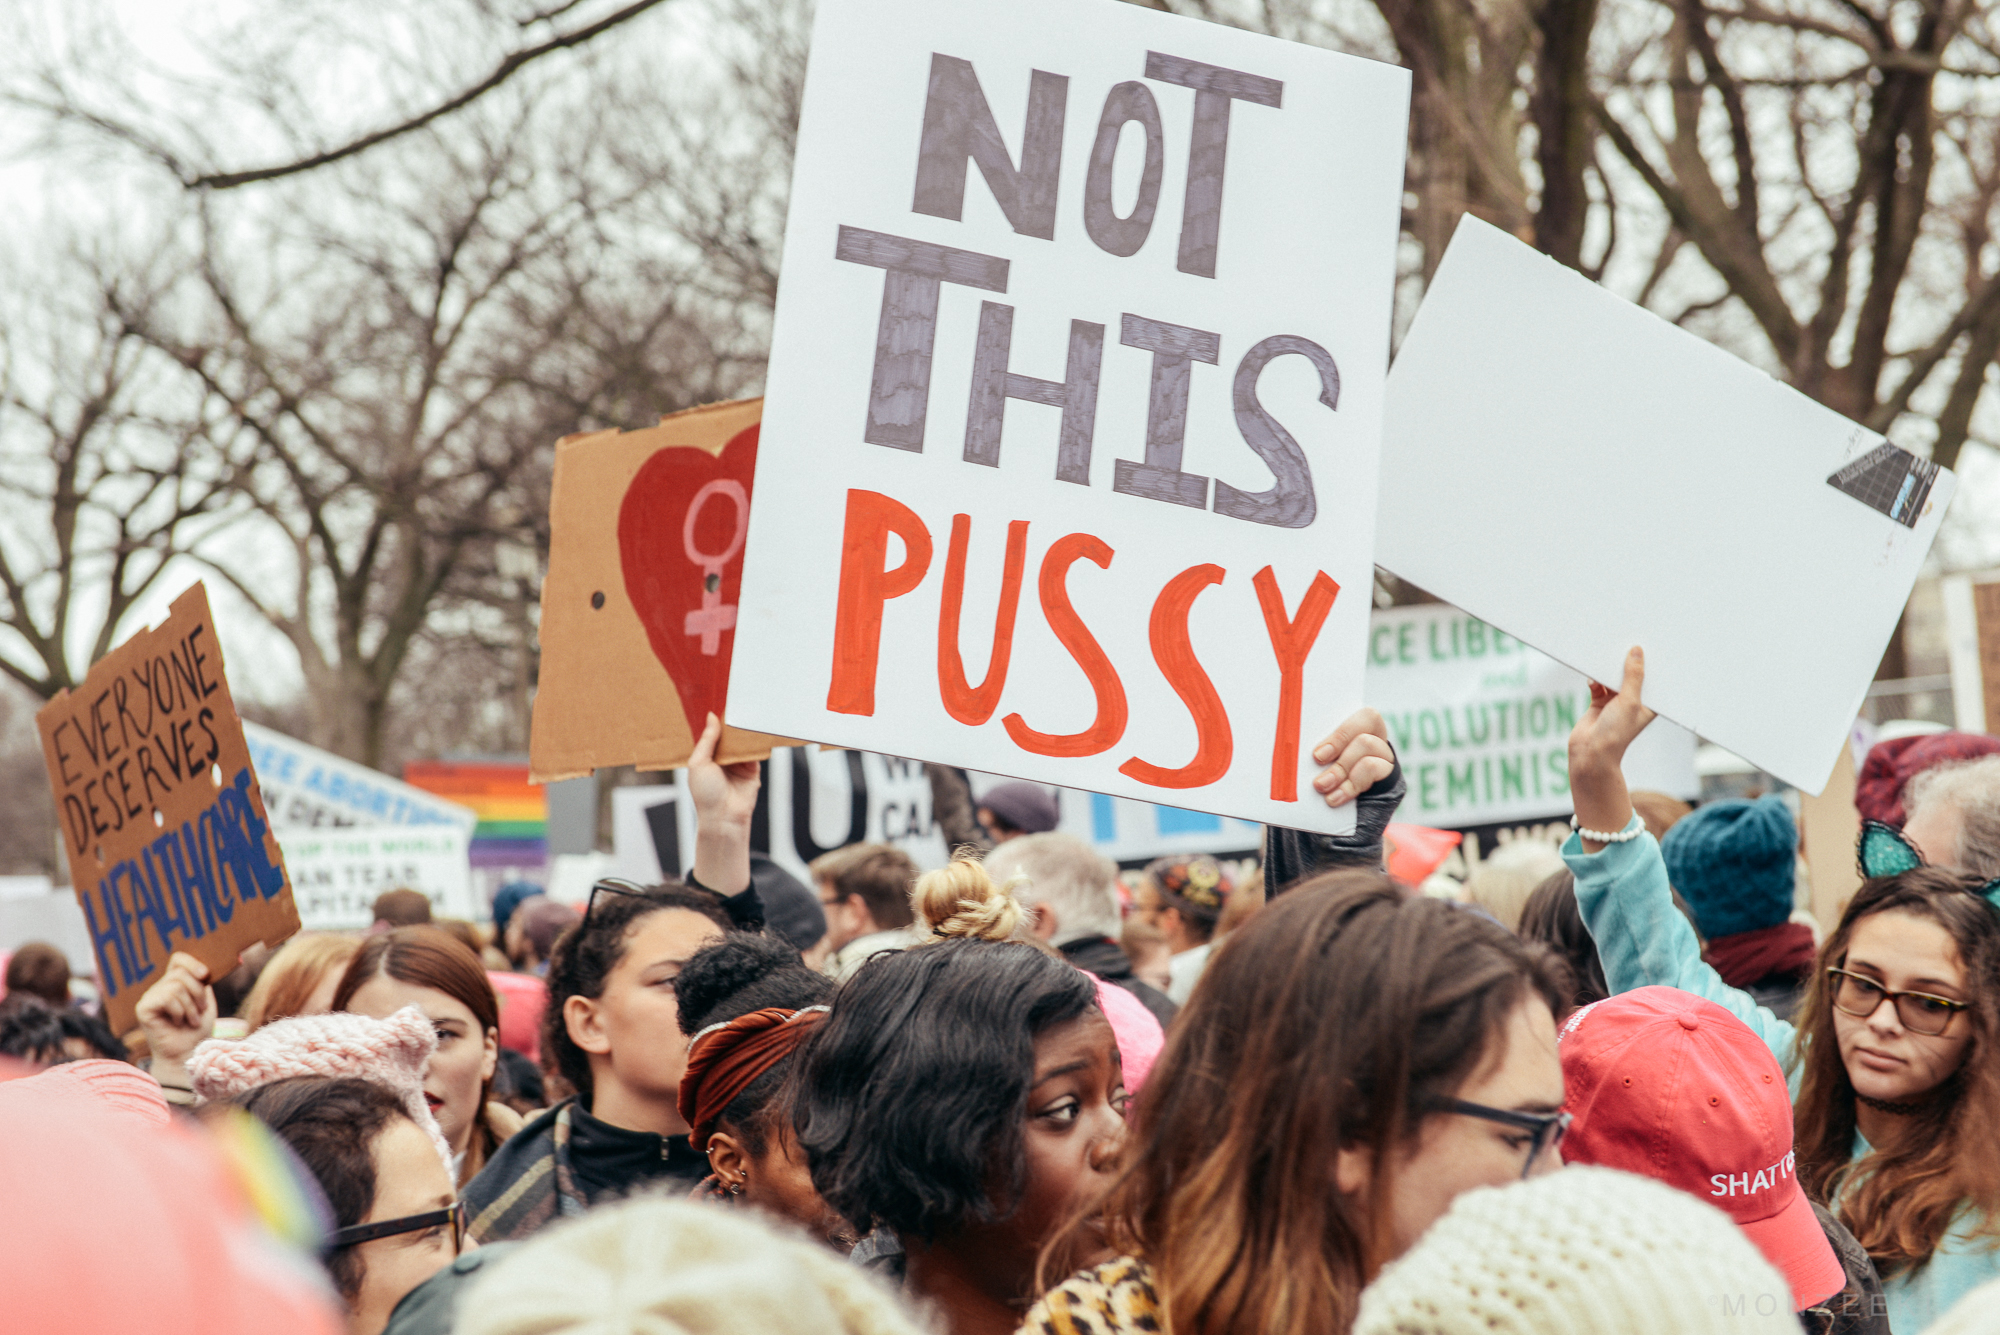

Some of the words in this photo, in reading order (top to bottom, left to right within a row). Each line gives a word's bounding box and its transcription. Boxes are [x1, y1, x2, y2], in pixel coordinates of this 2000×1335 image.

[911, 50, 1283, 279] NOT
[835, 224, 1340, 529] THIS
[53, 624, 218, 787] EVERYONE
[827, 489, 1341, 802] PUSSY
[1428, 617, 1526, 663] LIBE
[64, 707, 220, 856] DESERVES
[1398, 748, 1571, 812] EMINIS
[82, 767, 285, 997] HEALTHCARE
